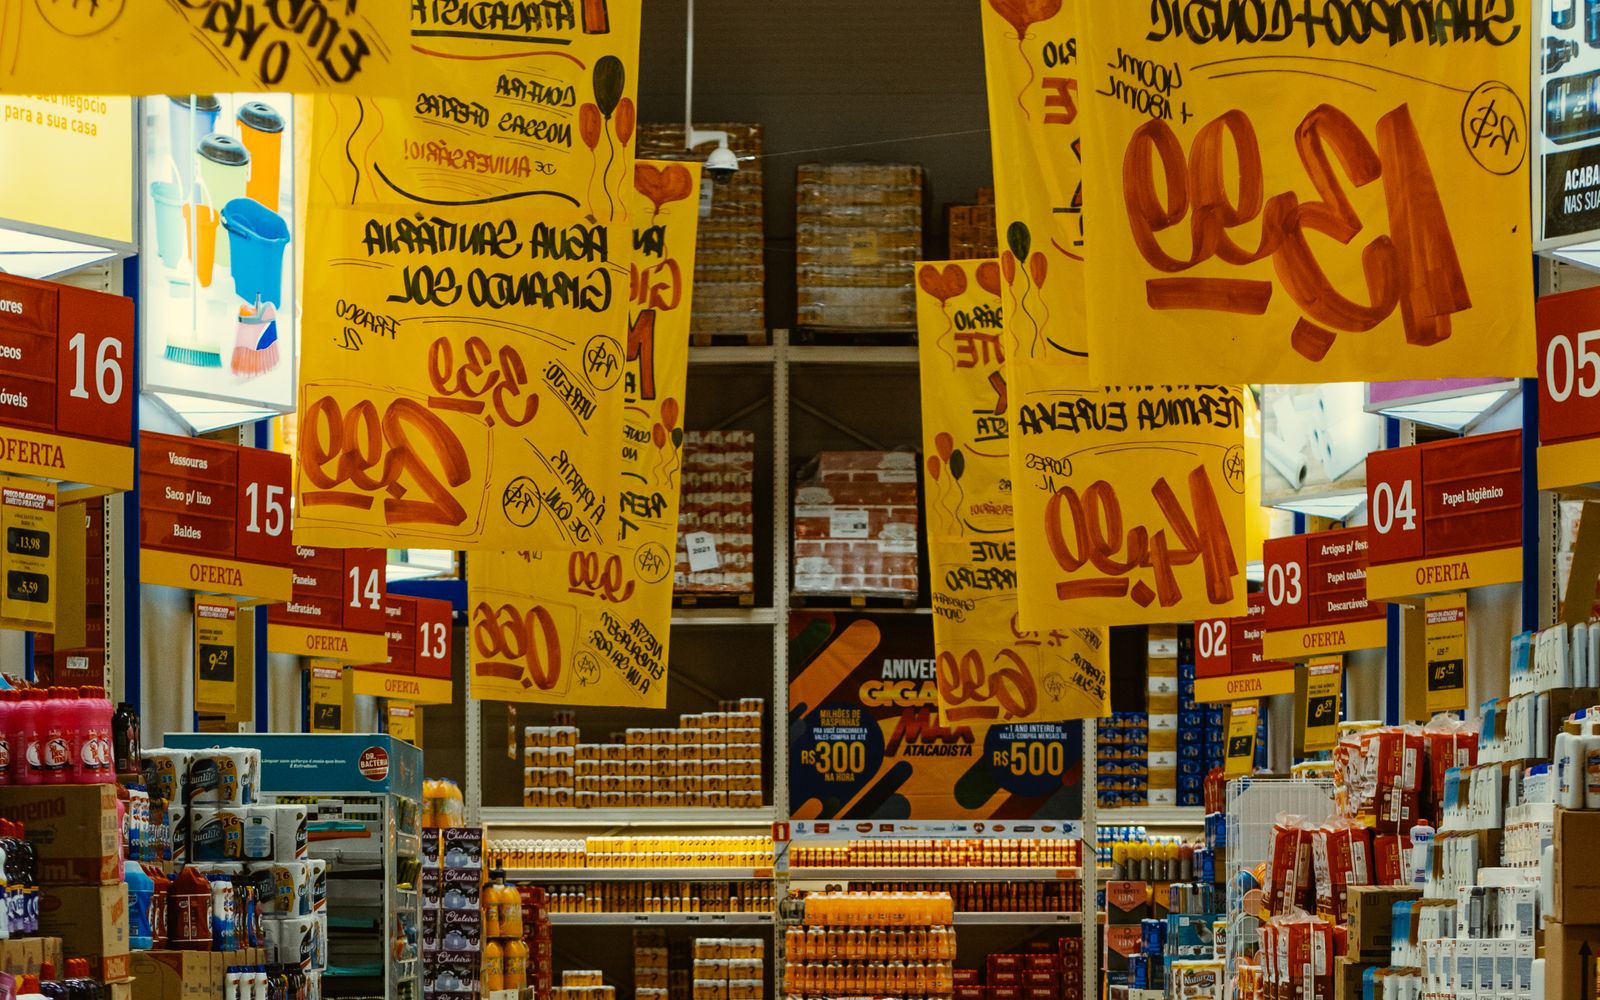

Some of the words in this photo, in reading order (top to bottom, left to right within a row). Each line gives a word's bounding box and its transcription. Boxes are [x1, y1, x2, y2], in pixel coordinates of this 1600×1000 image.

[4, 105, 33, 122] para
[36, 111, 43, 125] a
[47, 113, 67, 130] sua
[71, 119, 97, 136] casa
[1564, 193, 1583, 214] NAS
[69, 332, 123, 405] 16
[1546, 330, 1600, 402] 05
[168, 452, 208, 469] Vassouras
[165, 486, 185, 501] Saco
[186, 489, 196, 505] p/
[196, 491, 212, 505] lixo
[1442, 490, 1465, 507] Papel
[1466, 486, 1504, 504] higiênico
[246, 482, 284, 537] 15
[1372, 479, 1417, 534] 04
[173, 524, 202, 539] Baldes
[296, 545, 315, 558] Copos
[1321, 544, 1345, 556] Artigos
[1346, 541, 1354, 554] p/
[1354, 540, 1368, 551] fest
[189, 563, 243, 587] OFERTA
[1327, 571, 1345, 584] Papel
[1415, 562, 1470, 585] OFERTA
[349, 566, 381, 610] 14
[1267, 561, 1302, 606] 03
[1327, 597, 1368, 612] Descartáveis
[306, 634, 349, 652] OFERTA
[420, 622, 447, 659] 13
[1198, 620, 1227, 658] 02
[1303, 630, 1346, 648] OFERTA
[384, 679, 420, 695] OFERTA
[1226, 678, 1262, 694] OFERTA
[820, 707, 851, 719] MILHÕES
[851, 708, 861, 719] DE
[820, 719, 860, 728] RASPINHAS
[1014, 724, 1028, 733] ANO
[1029, 724, 1054, 733] INTEIRO
[903, 743, 973, 757] ATACADISTA
[824, 772, 835, 782] NA
[836, 772, 856, 782] HORA
